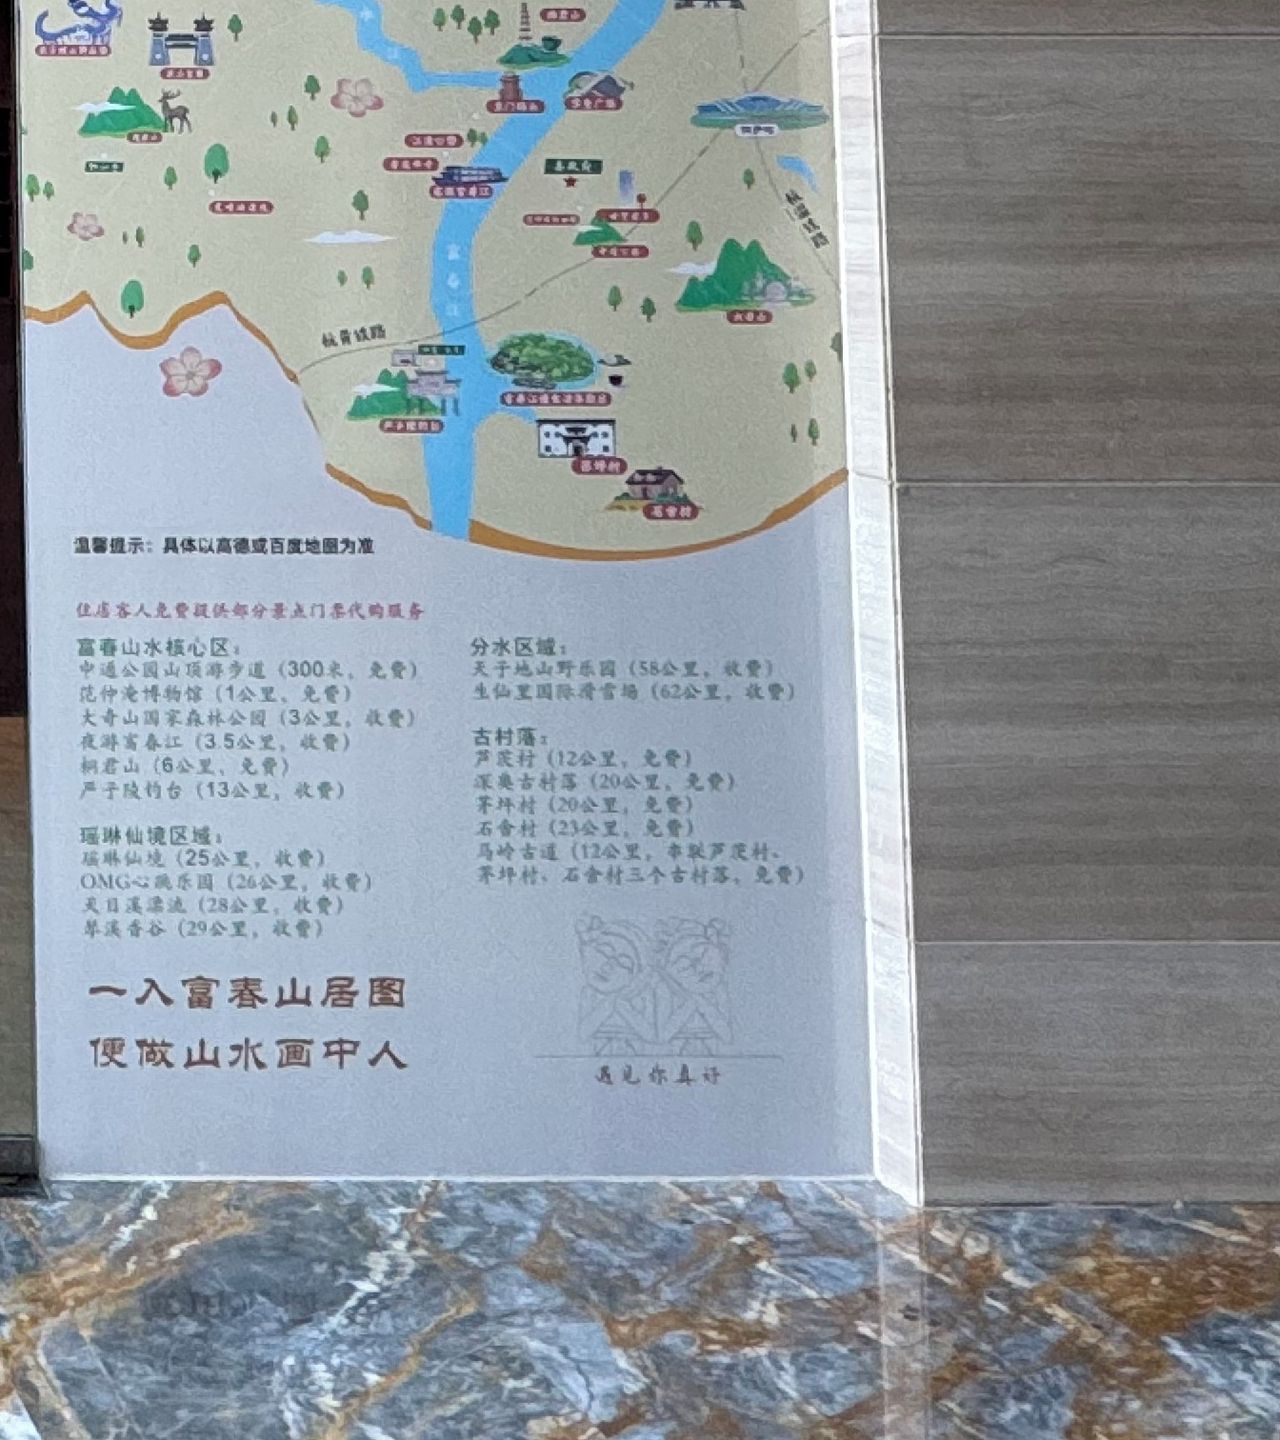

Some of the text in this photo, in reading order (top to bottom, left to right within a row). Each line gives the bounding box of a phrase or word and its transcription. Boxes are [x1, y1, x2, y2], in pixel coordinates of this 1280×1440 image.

[88, 975, 406, 1009] 一入富春山居图
[88, 1037, 408, 1071] 便做山水画中人
